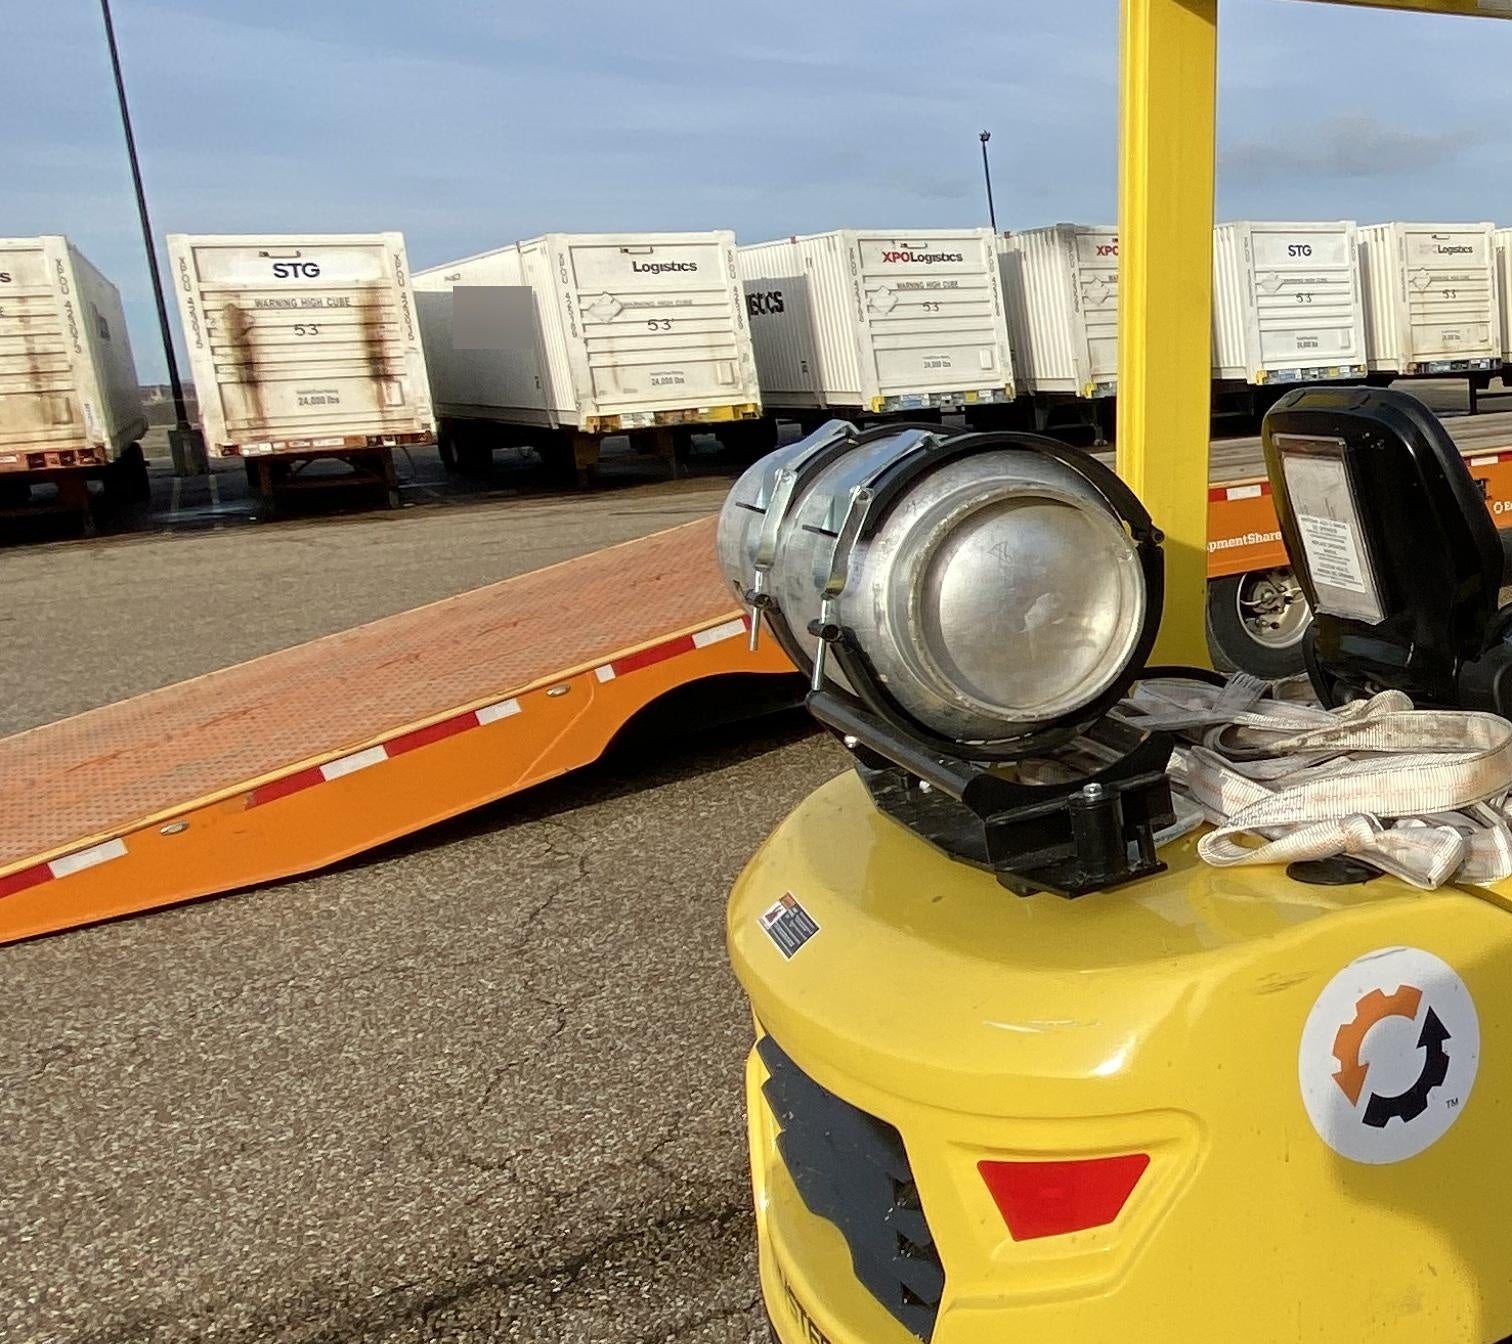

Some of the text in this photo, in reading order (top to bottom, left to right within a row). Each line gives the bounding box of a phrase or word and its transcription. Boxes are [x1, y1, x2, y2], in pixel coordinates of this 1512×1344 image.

[1288, 244, 1313, 257] STG
[1437, 244, 1474, 256] Logistics
[272, 262, 321, 279] STG
[632, 260, 698, 275] Logistics
[254, 296, 351, 308] WARNING HIGH CUBE
